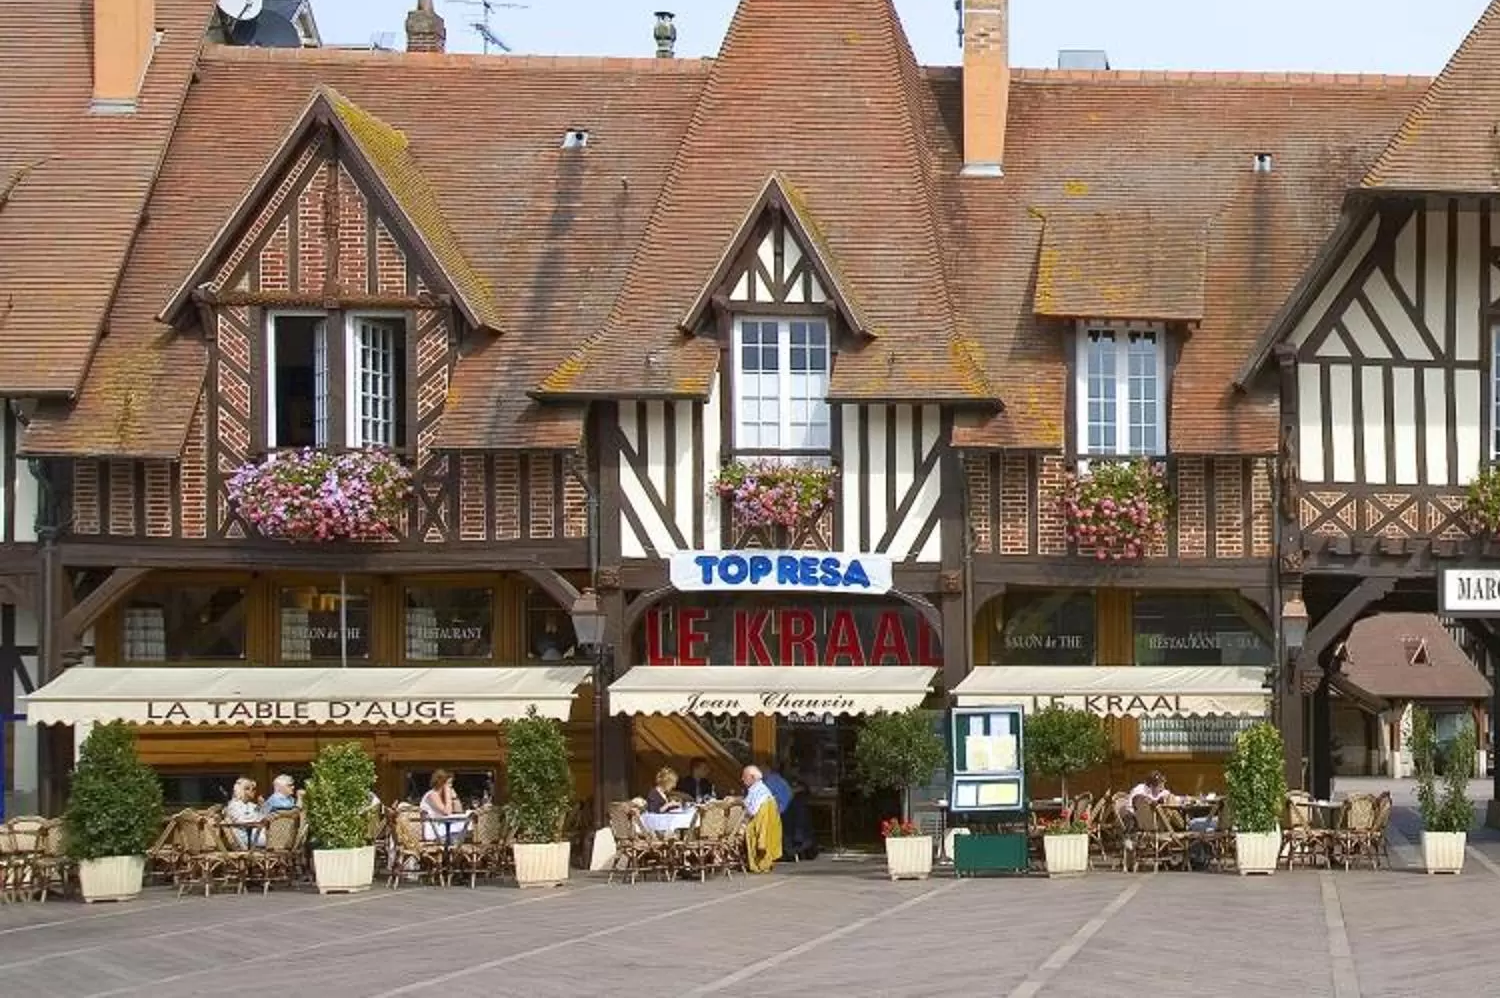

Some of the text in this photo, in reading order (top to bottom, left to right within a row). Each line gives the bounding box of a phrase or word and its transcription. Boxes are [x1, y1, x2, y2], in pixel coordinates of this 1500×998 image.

[695, 555, 870, 588] TOP RESA
[645, 605, 944, 666] LE KRAAL
[1058, 634, 1085, 650] THE
[148, 701, 456, 719] LA TABLE D'AUGE
[680, 691, 740, 713] Jean
[1085, 695, 1189, 712] KRAAL
